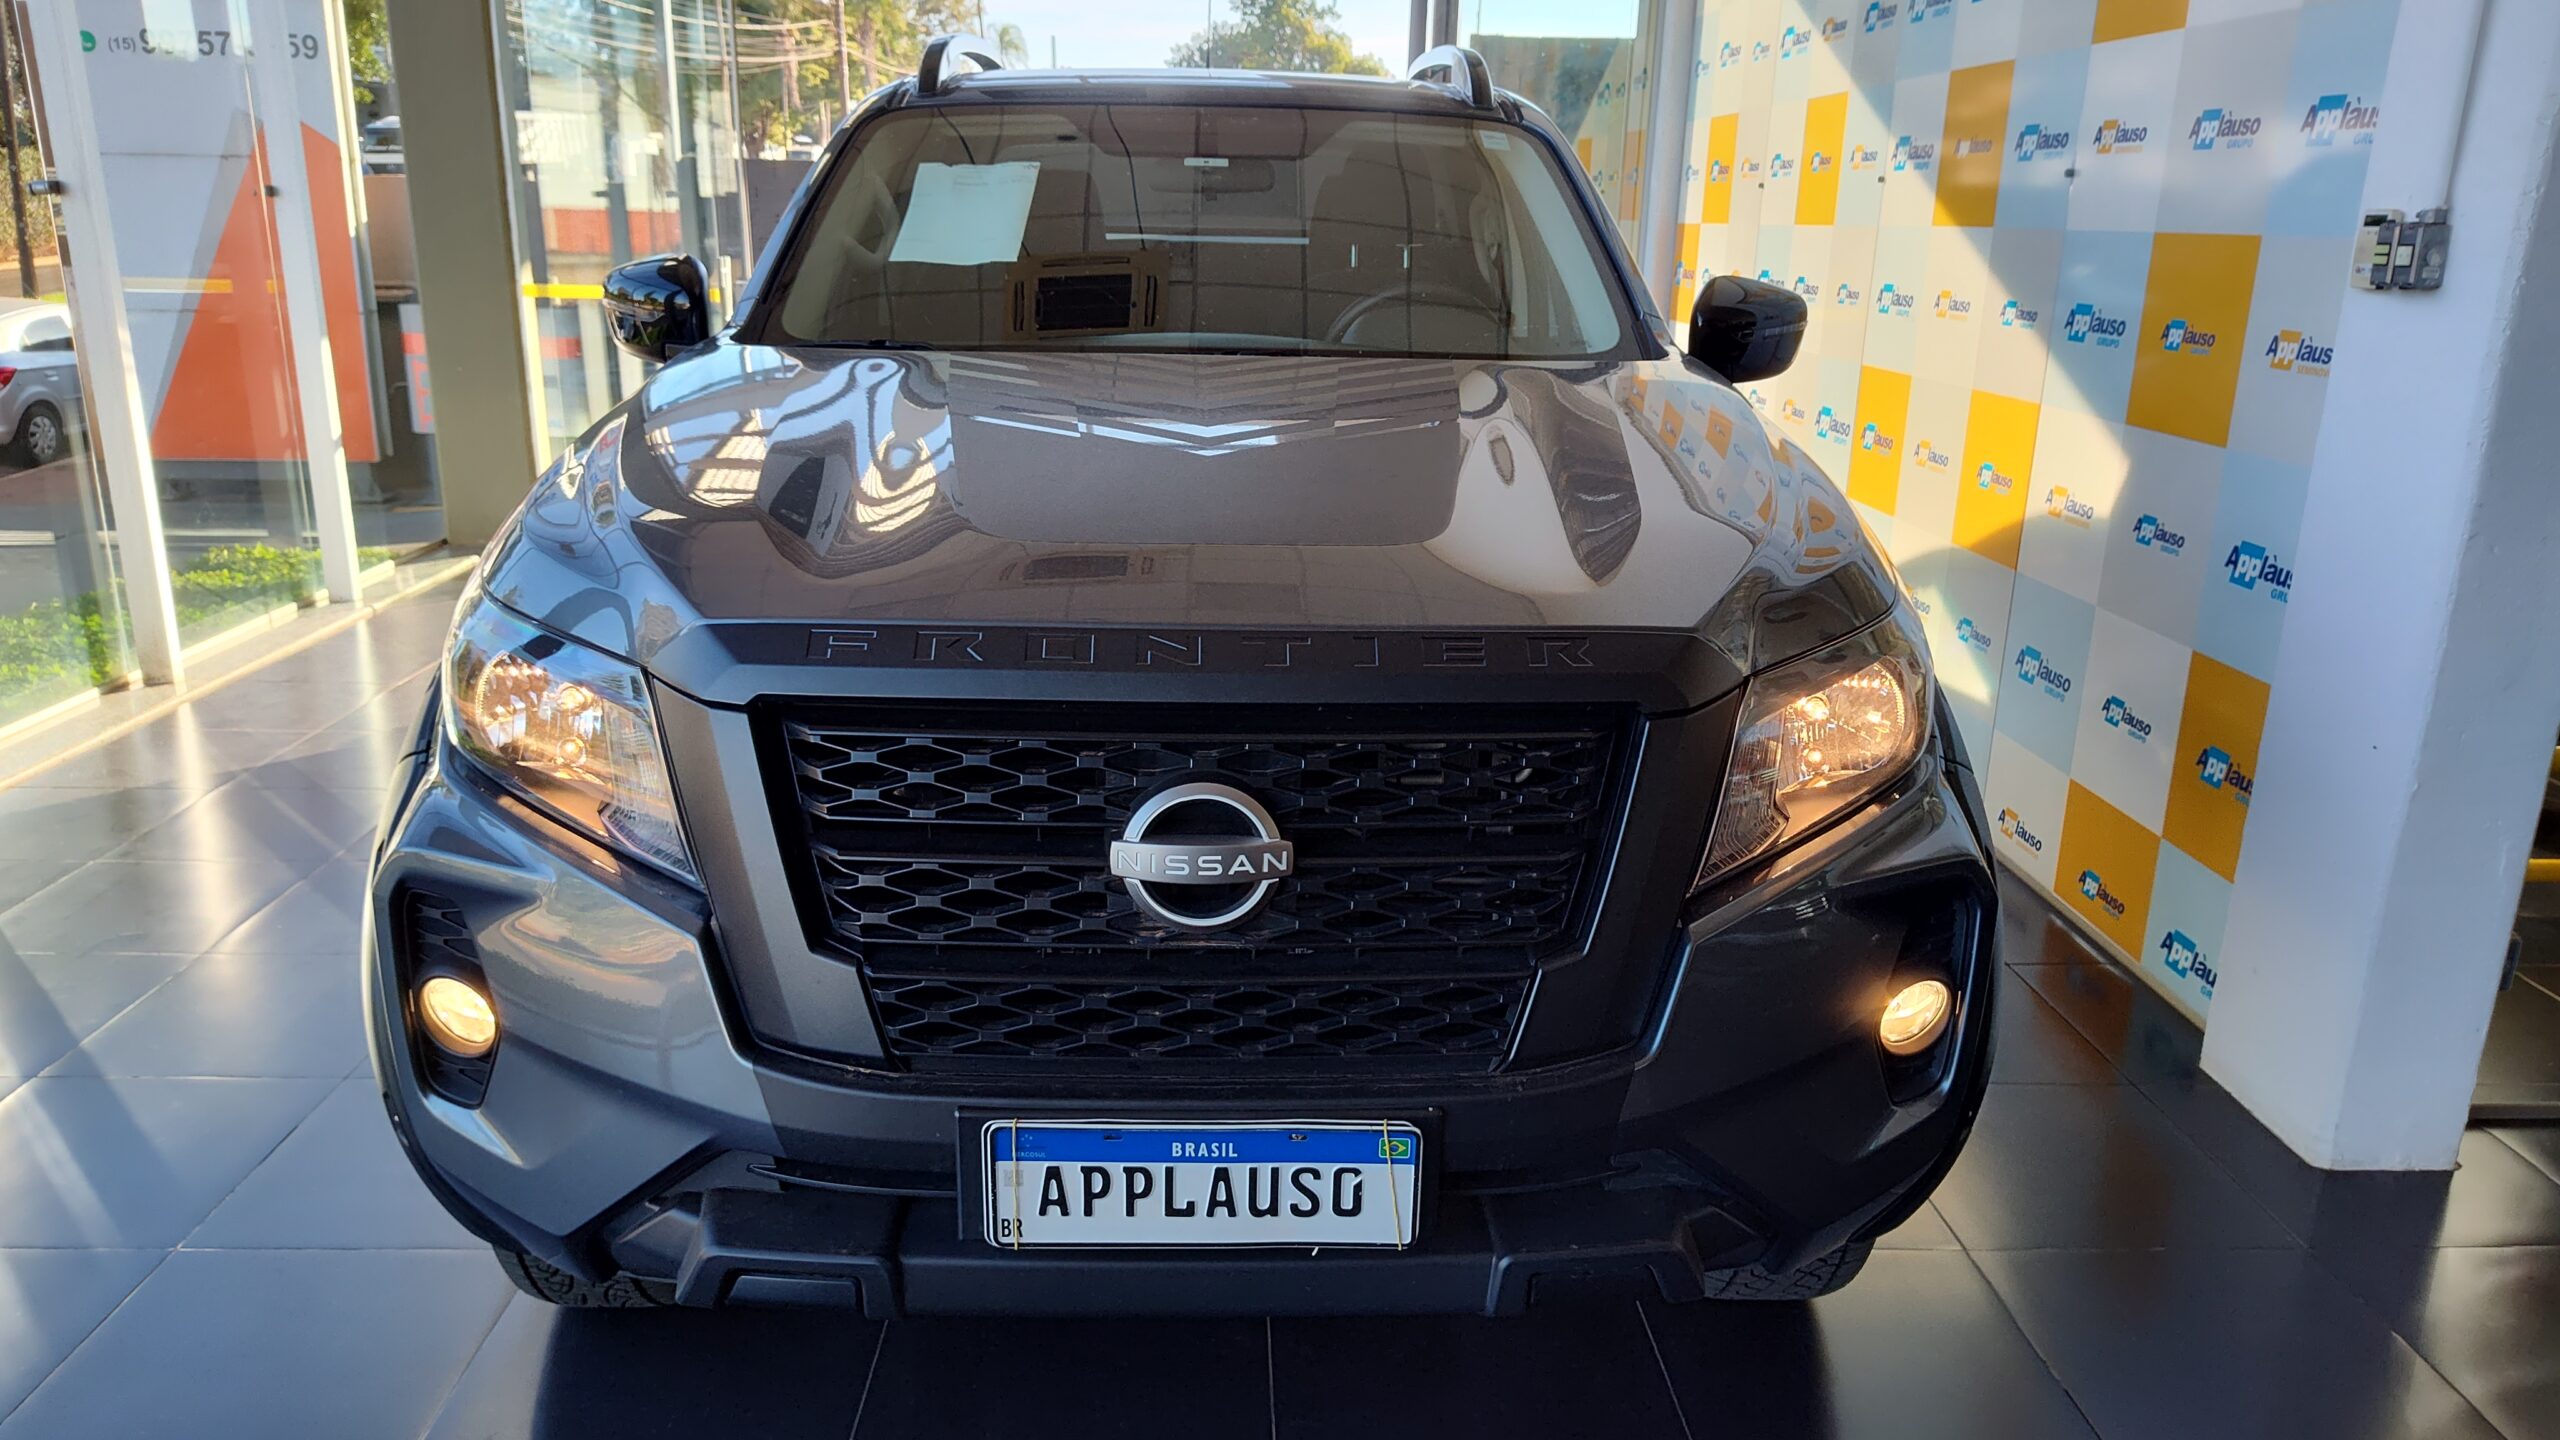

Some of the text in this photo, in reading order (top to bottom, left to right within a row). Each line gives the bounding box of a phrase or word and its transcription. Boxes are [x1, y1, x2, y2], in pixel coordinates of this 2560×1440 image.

[108, 37, 136, 52] (15)
[805, 627, 1595, 668] FRONTIER
[1116, 849, 1288, 876] NISSAN
[1171, 1142, 1238, 1158] BRASIL
[1038, 1165, 1363, 1218] APPLAUSO
[1001, 1218, 1023, 1238] BR
